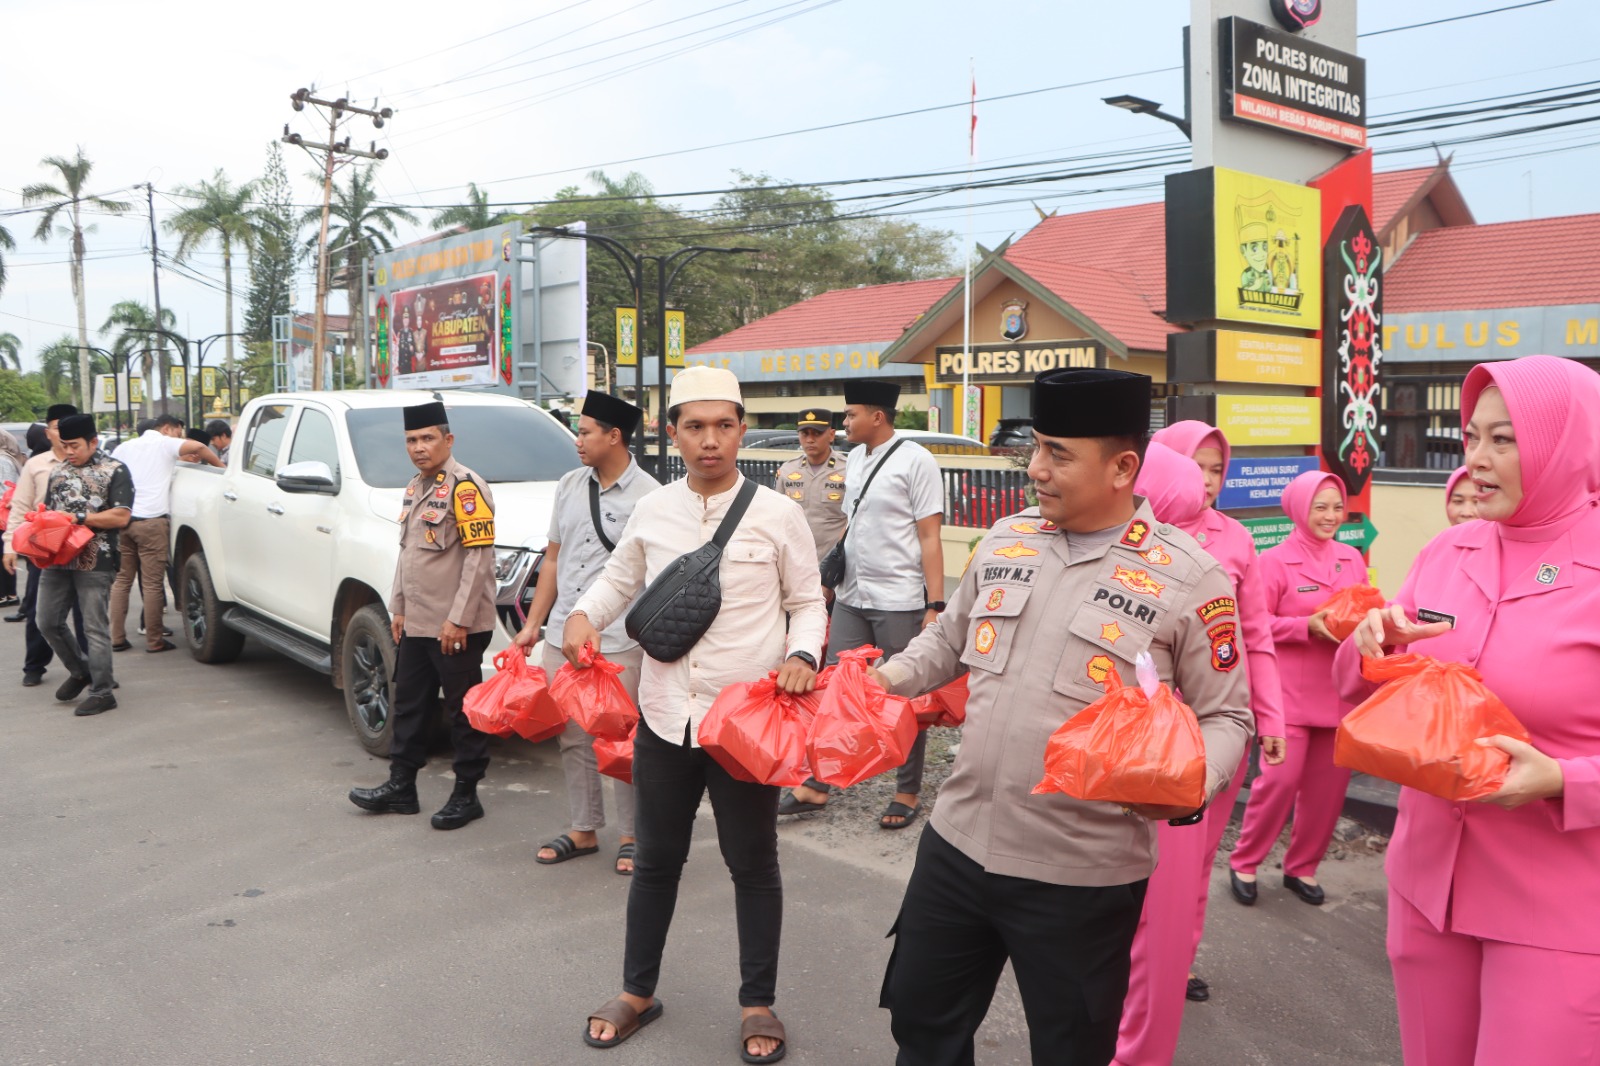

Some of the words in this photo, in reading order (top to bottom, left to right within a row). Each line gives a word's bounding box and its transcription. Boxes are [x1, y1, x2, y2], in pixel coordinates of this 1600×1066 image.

[1257, 38, 1307, 71] POLRES
[1310, 55, 1348, 84] KOTIM
[1242, 62, 1282, 96] ZONA
[1285, 75, 1360, 117] INTEGRITAS
[1240, 99, 1278, 119] WILAYAH
[1279, 109, 1306, 127] BEBAS
[1307, 116, 1340, 135] KORUPSI
[432, 315, 486, 337] KABUPATEN
[1383, 320, 1521, 350] TULUS
[761, 351, 880, 373] MERESPON
[940, 350, 1020, 375] POLRES
[1024, 347, 1096, 373] KOTIM
[1241, 466, 1278, 476] PELAYANAN
[1278, 465, 1299, 474] SURAT
[1225, 478, 1269, 488] KETERANGAN
[427, 500, 447, 510] POLRI
[469, 520, 494, 539] SPKT
[1339, 529, 1365, 541] MASUK
[983, 566, 1011, 581] RESKY
[1093, 588, 1157, 625] POLRI
[1200, 599, 1234, 617] POLRES
